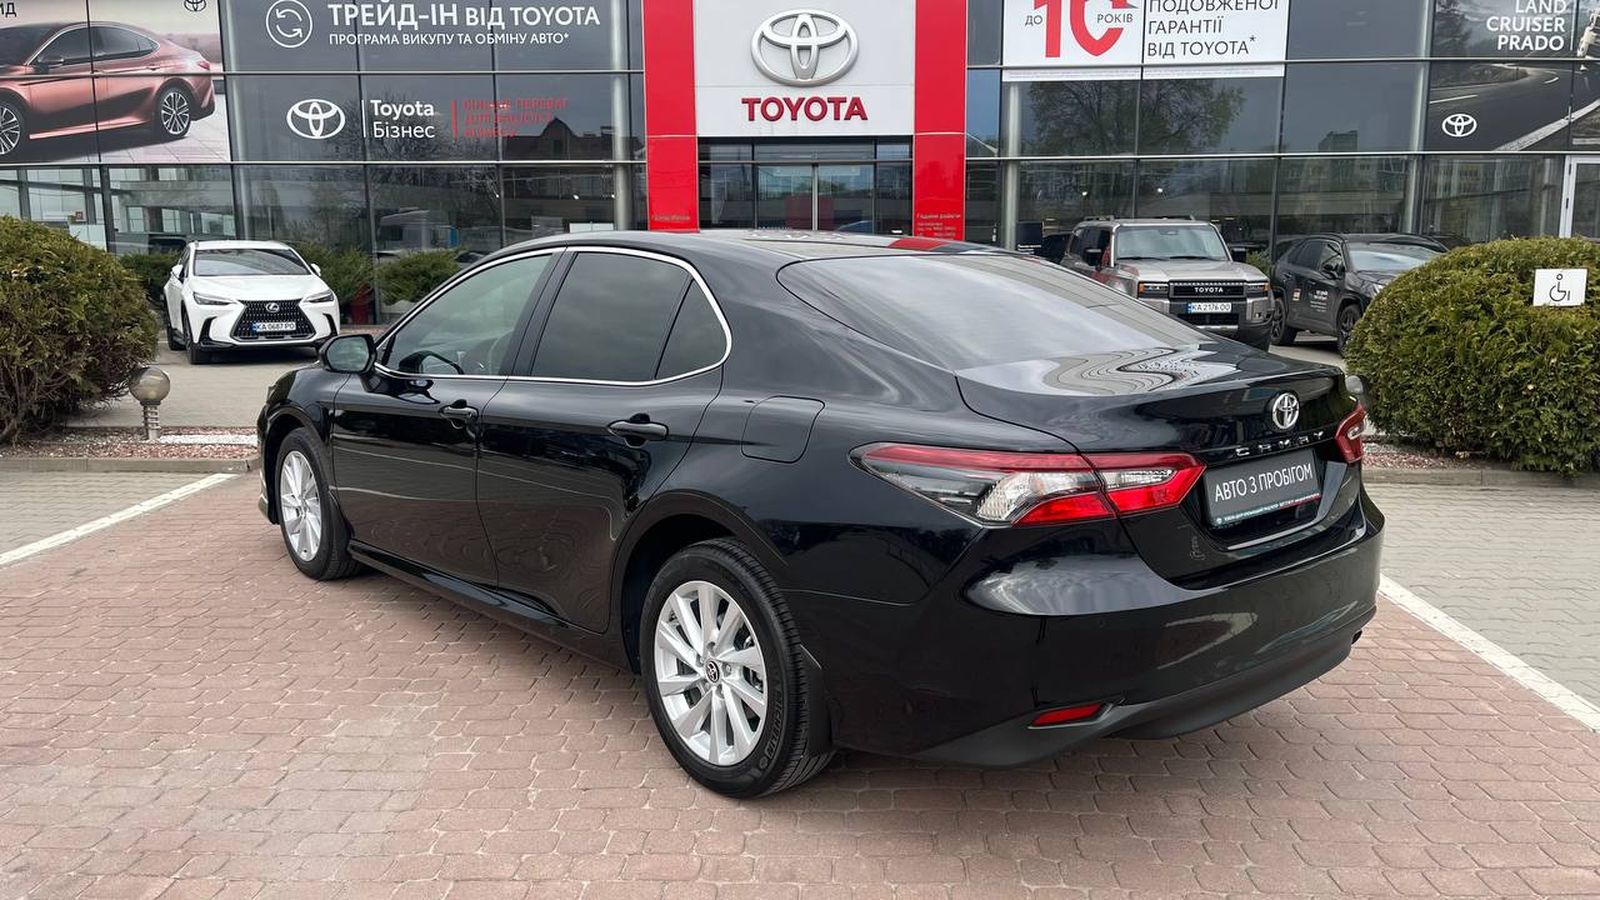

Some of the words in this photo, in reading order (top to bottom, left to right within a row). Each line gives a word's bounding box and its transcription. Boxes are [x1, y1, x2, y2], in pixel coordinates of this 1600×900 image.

[328, 0, 458, 30] ТРЕЙД-ІН
[466, 7, 505, 30] ВІД
[510, 7, 600, 26] TOYOTA
[1516, 0, 1566, 14] LAND
[1025, 15, 1043, 26] ДО
[1097, 13, 1133, 24] РОКІВ
[1148, 16, 1224, 34] ГАРАНТІЇ
[1486, 16, 1565, 32] CRUISER
[329, 33, 399, 45] ПРОГРАМА
[402, 33, 454, 45] ВИКУПУ
[457, 33, 472, 44] ТА
[475, 33, 527, 45] ОБМІНУ
[1497, 34, 1564, 51] PRADO
[1147, 42, 1175, 59] ВІД
[370, 99, 435, 120] Toyota
[741, 96, 868, 122] TOYOTA
[373, 121, 435, 139] Бізнес
[1235, 431, 1324, 457] CAMRY
[1215, 479, 1247, 502] АВТО
[1248, 476, 1258, 494] З
[1258, 463, 1313, 491] ПРОБІГОМ
